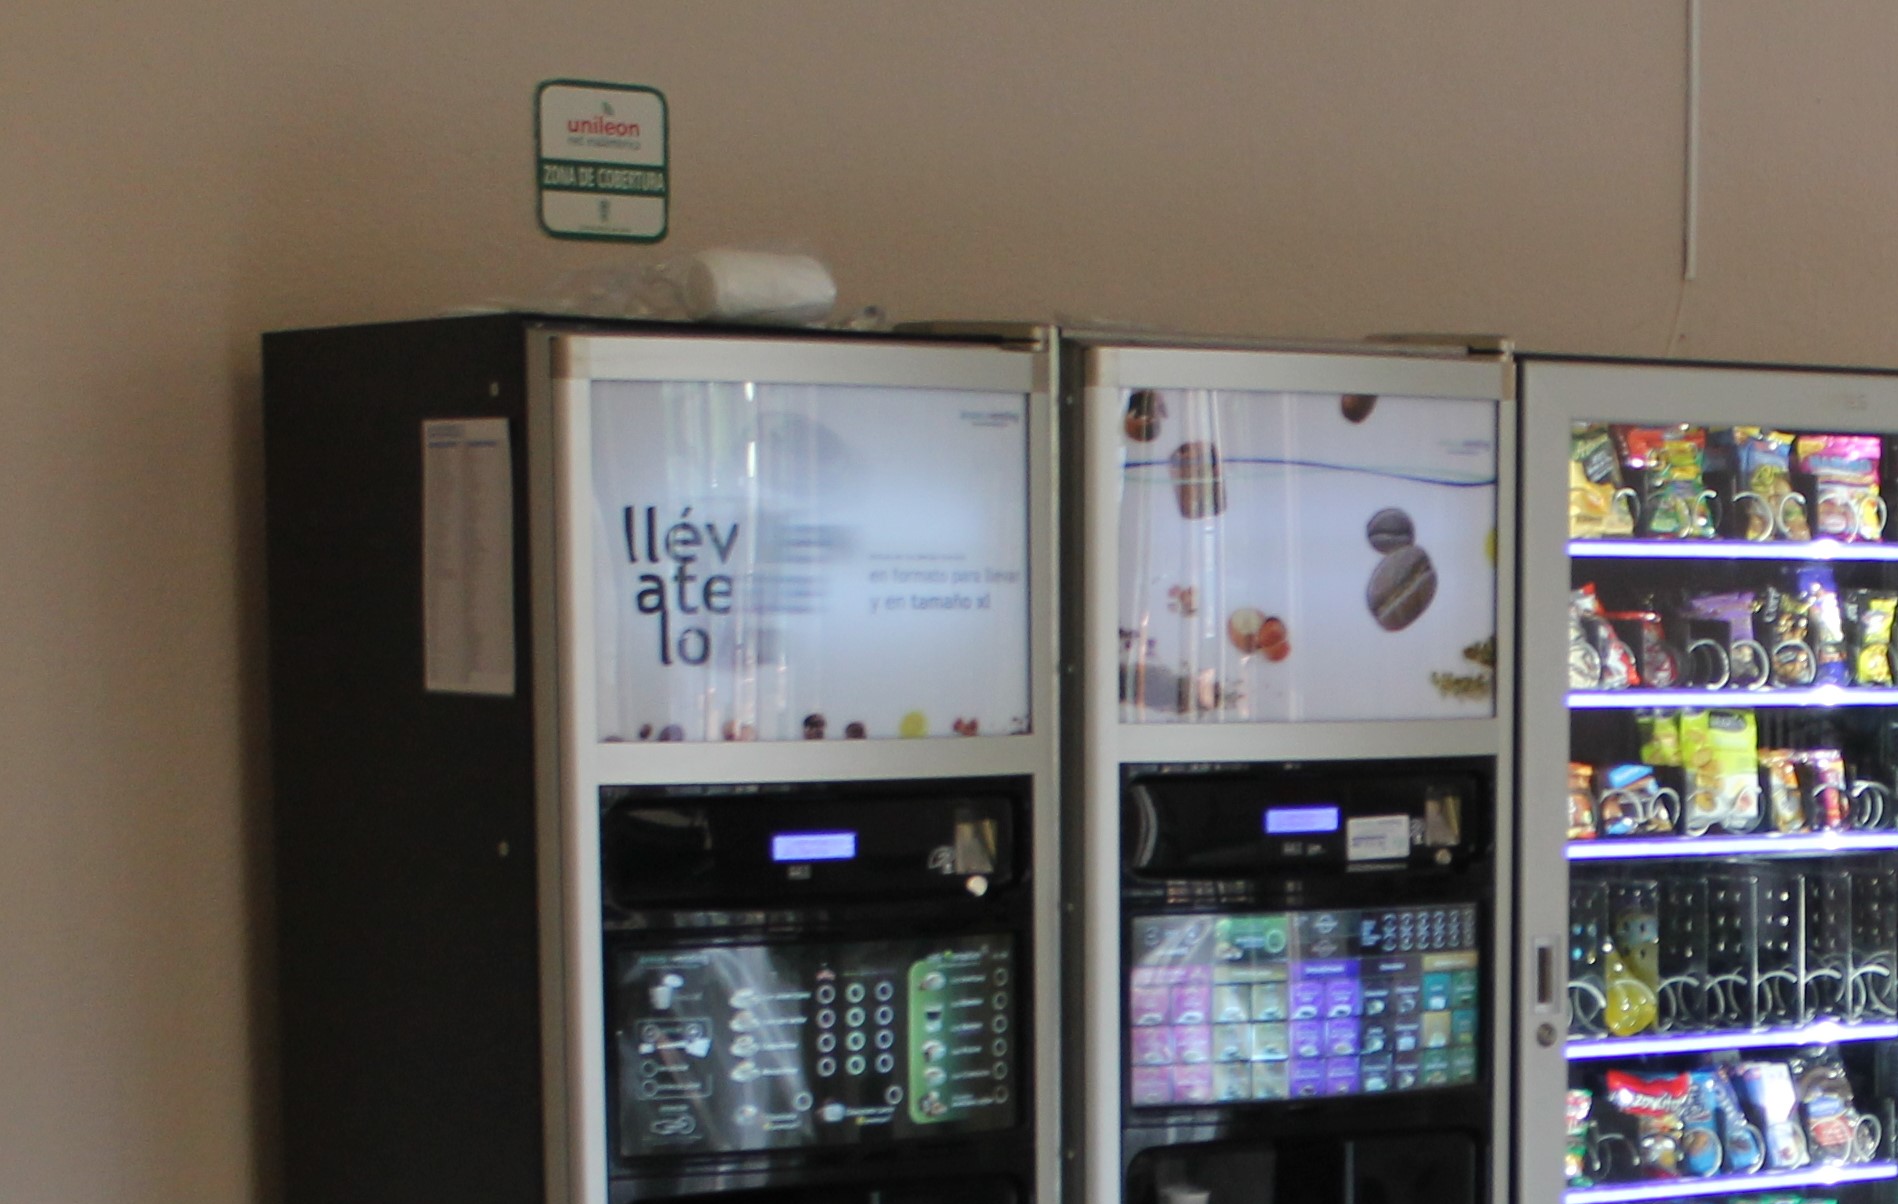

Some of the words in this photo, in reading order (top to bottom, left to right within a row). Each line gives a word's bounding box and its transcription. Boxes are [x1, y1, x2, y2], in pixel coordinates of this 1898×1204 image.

[566, 116, 641, 137] unileon
[542, 164, 576, 186] ZONA
[577, 166, 595, 188] DE
[596, 168, 665, 192] COBERTURA
